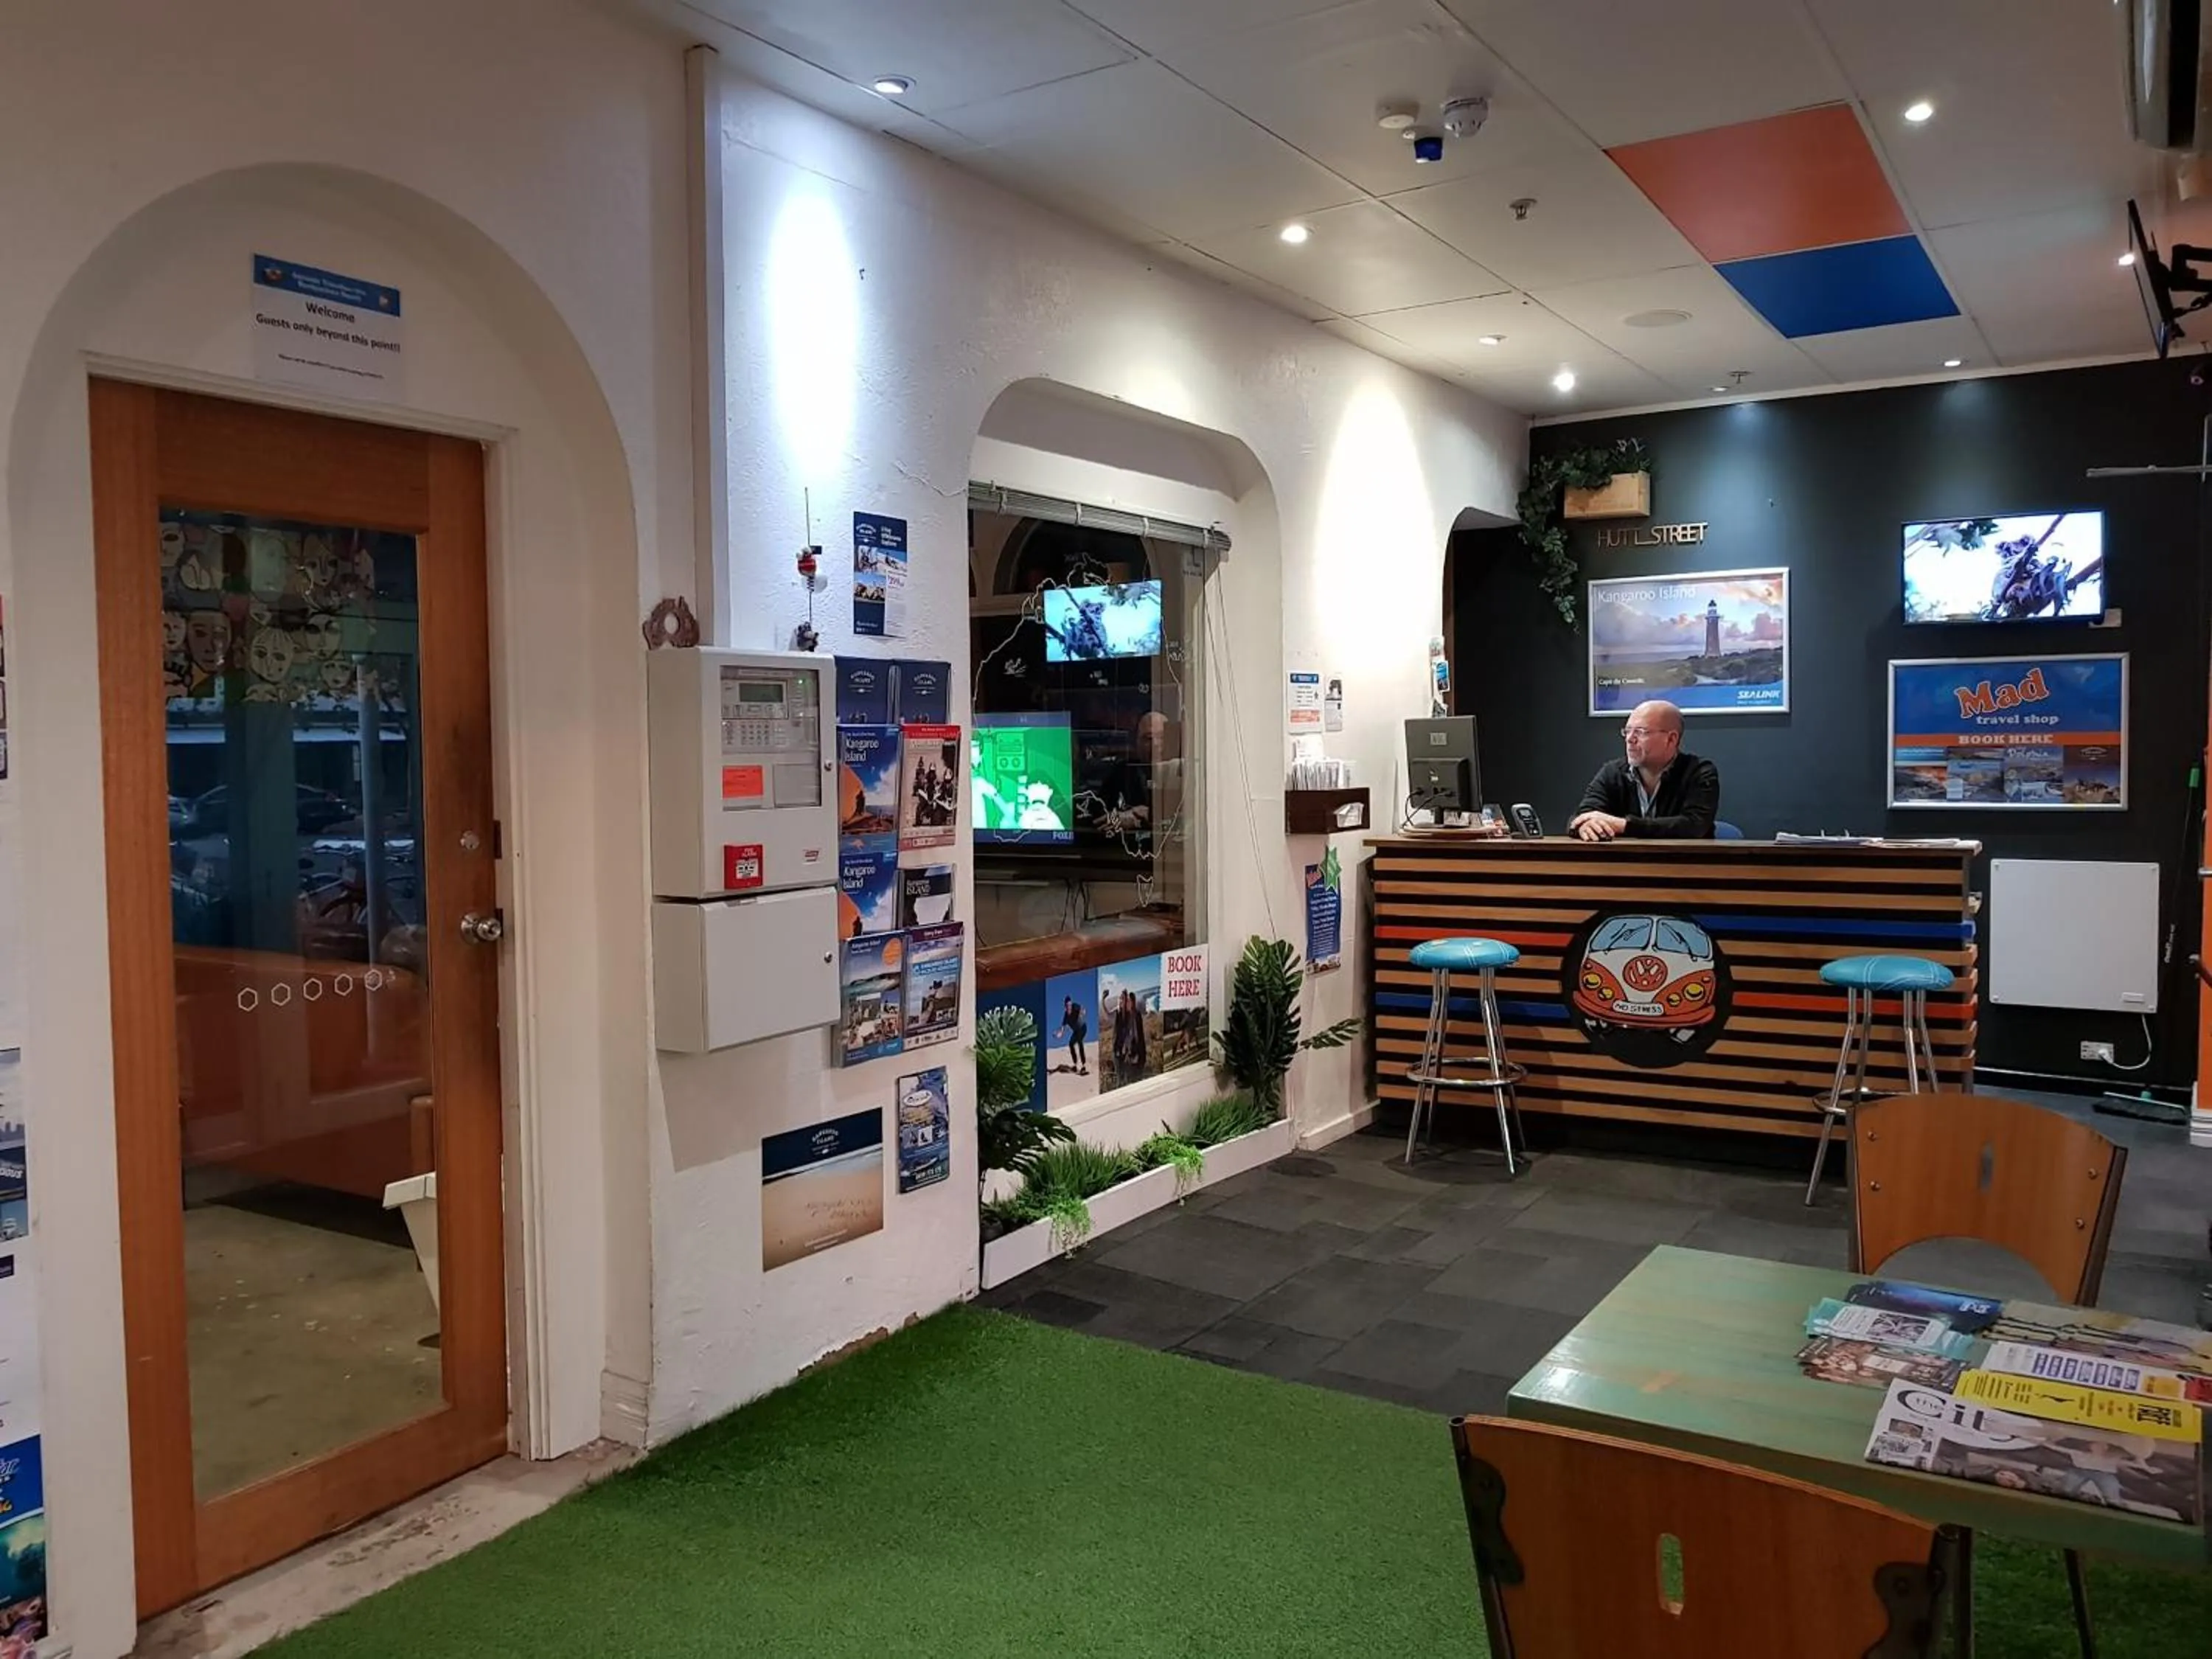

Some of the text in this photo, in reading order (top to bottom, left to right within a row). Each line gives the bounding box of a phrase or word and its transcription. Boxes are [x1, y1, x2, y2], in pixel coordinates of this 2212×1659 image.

[306, 301, 355, 324] Welcome
[256, 313, 291, 330] Guests
[293, 322, 313, 335] only
[316, 326, 349, 344] beyond
[352, 334, 369, 347] this
[1650, 521, 1709, 545] STREET
[1598, 585, 1697, 603] Kangaroo Island
[1736, 690, 1781, 700] SEALINK
[1954, 667, 2050, 719] Mad
[1976, 714, 2059, 726] travel shop
[846, 739, 879, 751] Kangaroo
[1958, 734, 2054, 745] BOOK HERE
[843, 865, 876, 878] Kangaroo
[1167, 955, 1202, 973] BOOK
[1169, 978, 1200, 998] HERE
